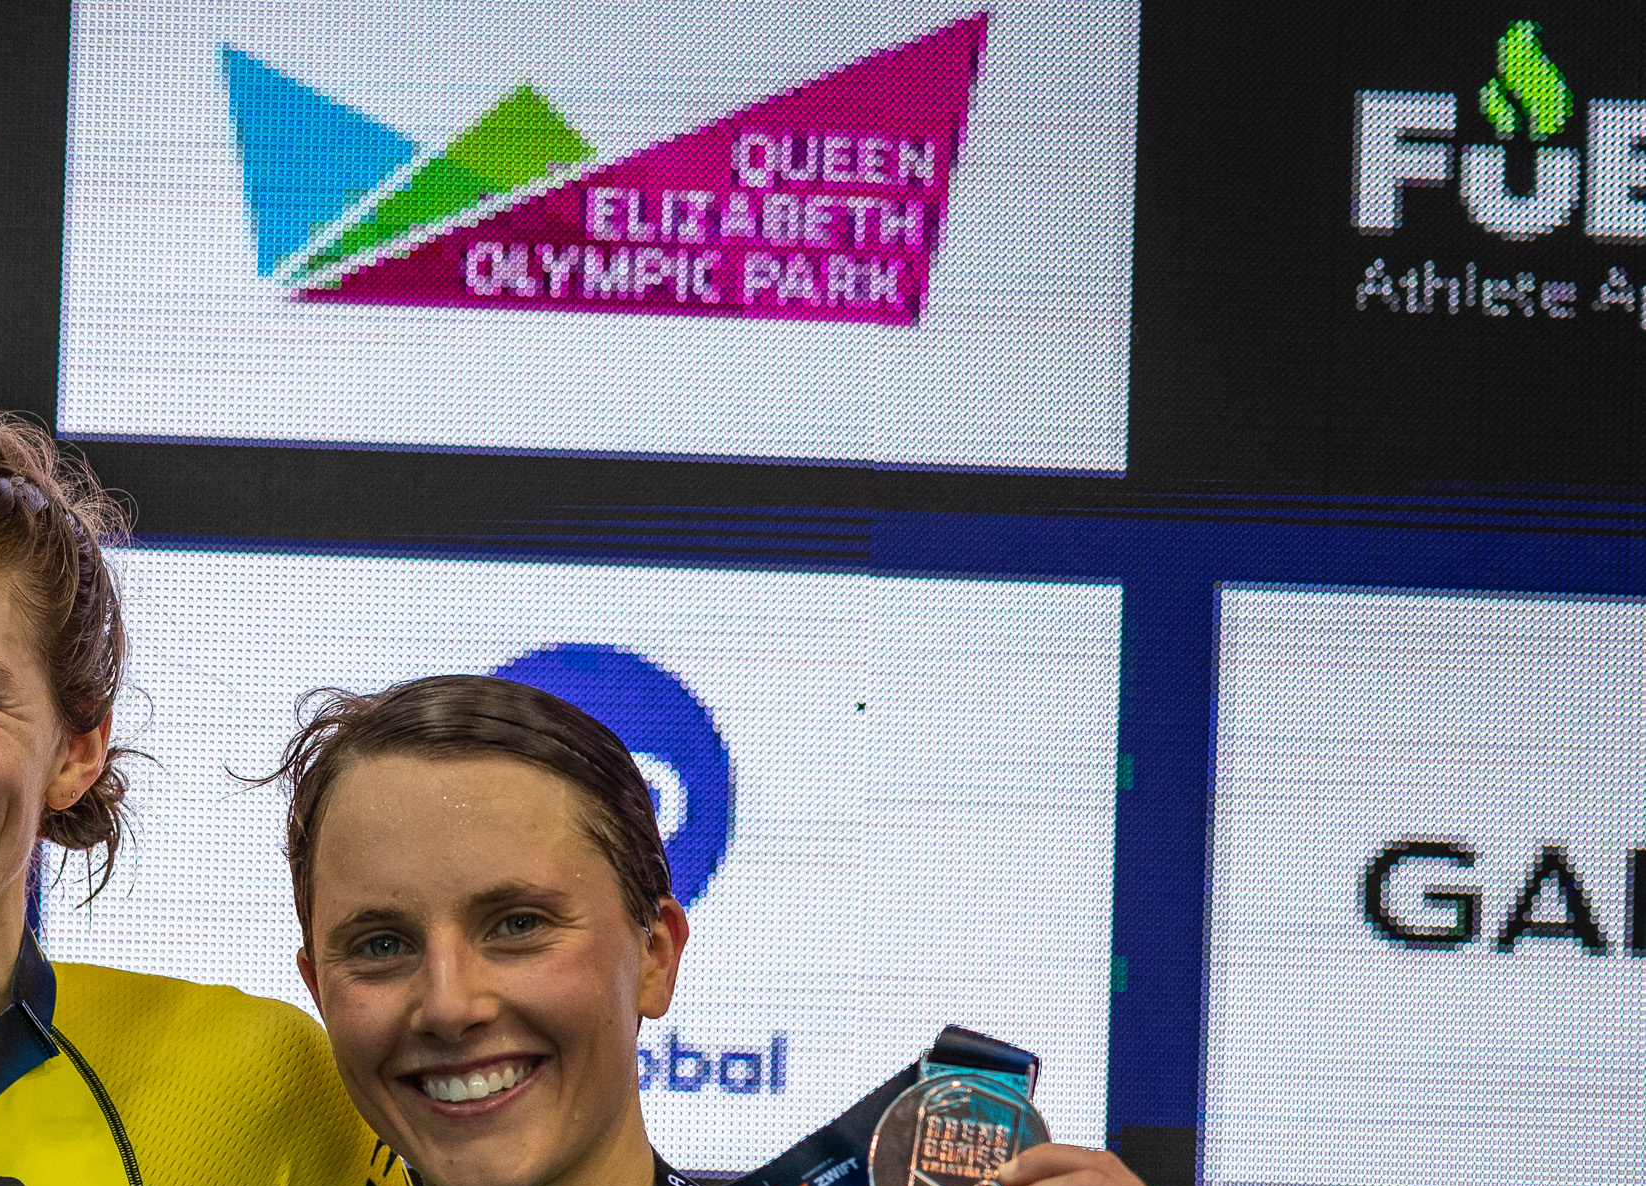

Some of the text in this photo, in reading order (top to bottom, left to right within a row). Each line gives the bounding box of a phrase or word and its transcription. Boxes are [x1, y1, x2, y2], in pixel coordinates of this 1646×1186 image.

[732, 133, 934, 188] QUEEN
[586, 187, 922, 248] ELIZABETH
[465, 241, 906, 312] OLYMPIC PARK
[1356, 258, 1578, 318] Athlete
[1357, 838, 1646, 958] GA
